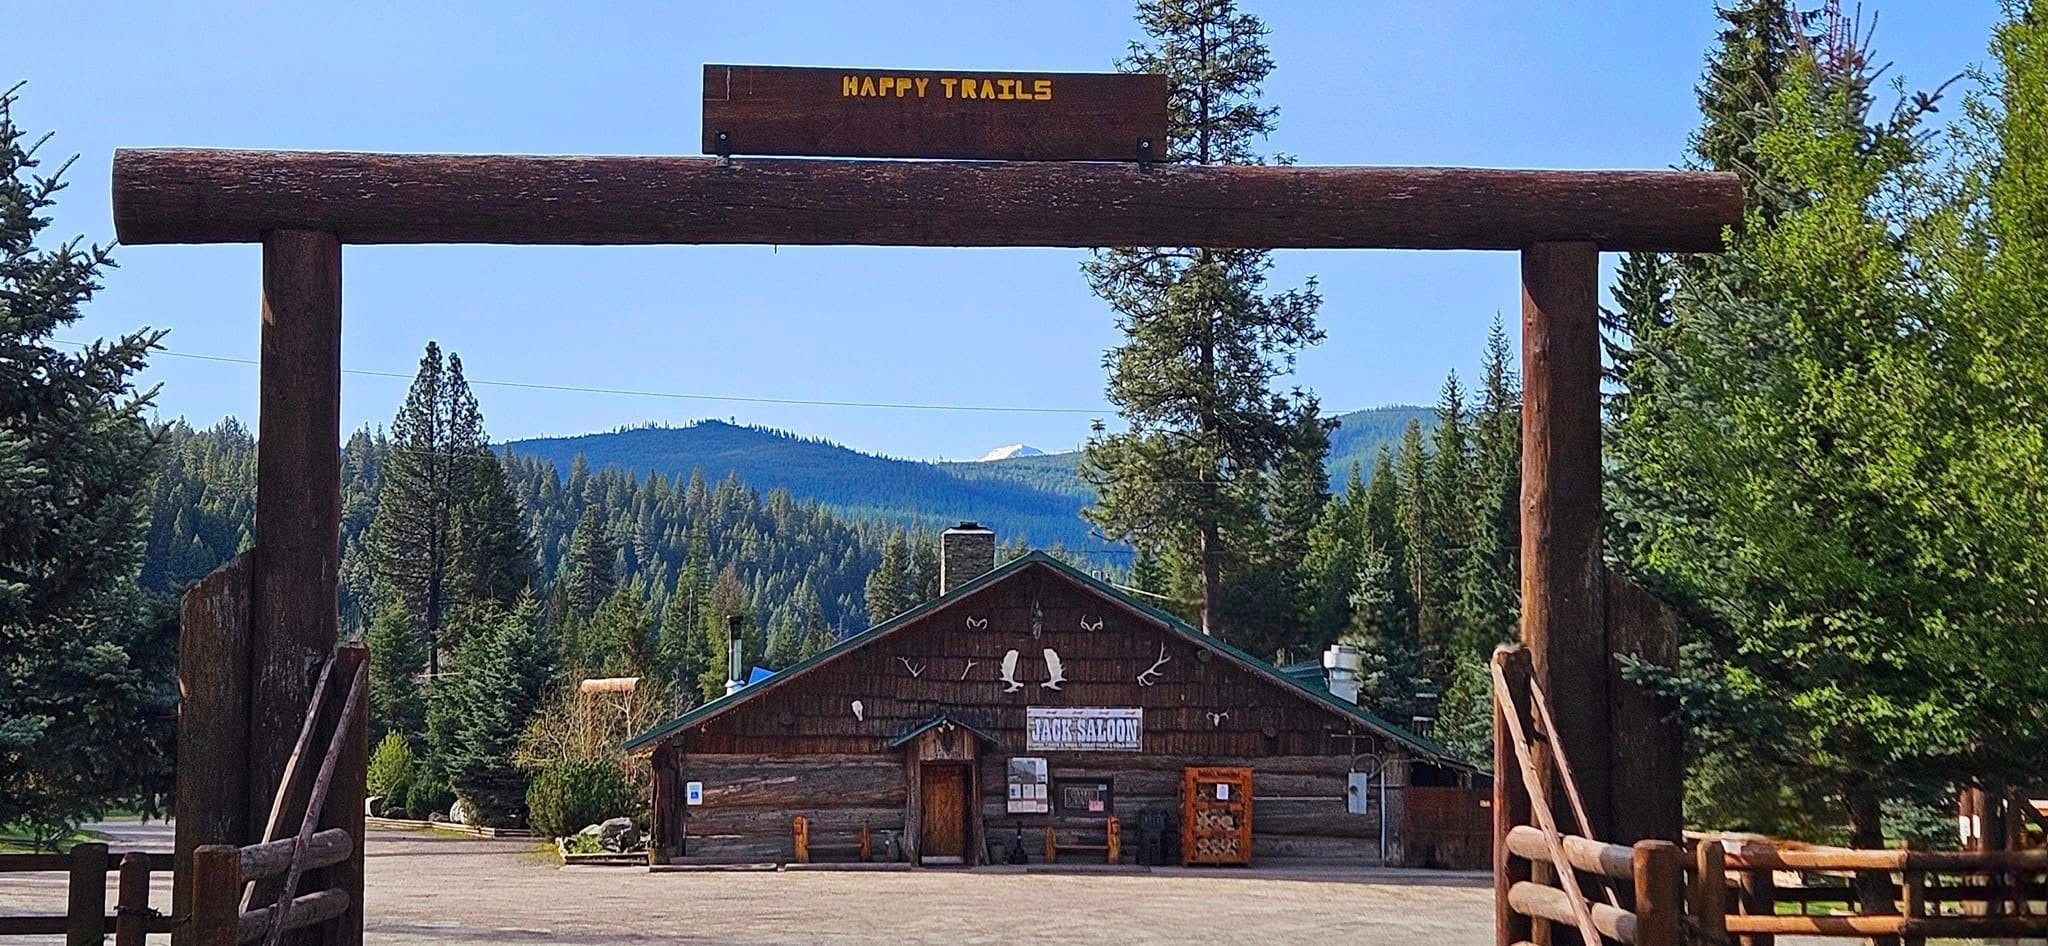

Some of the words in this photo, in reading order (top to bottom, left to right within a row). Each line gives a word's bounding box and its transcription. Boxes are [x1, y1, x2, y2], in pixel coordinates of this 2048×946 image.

[842, 76, 929, 97] HAPPY
[940, 78, 1052, 100] TRAILS
[1031, 718, 1073, 742] JACK
[1077, 718, 1138, 742] SALOON
